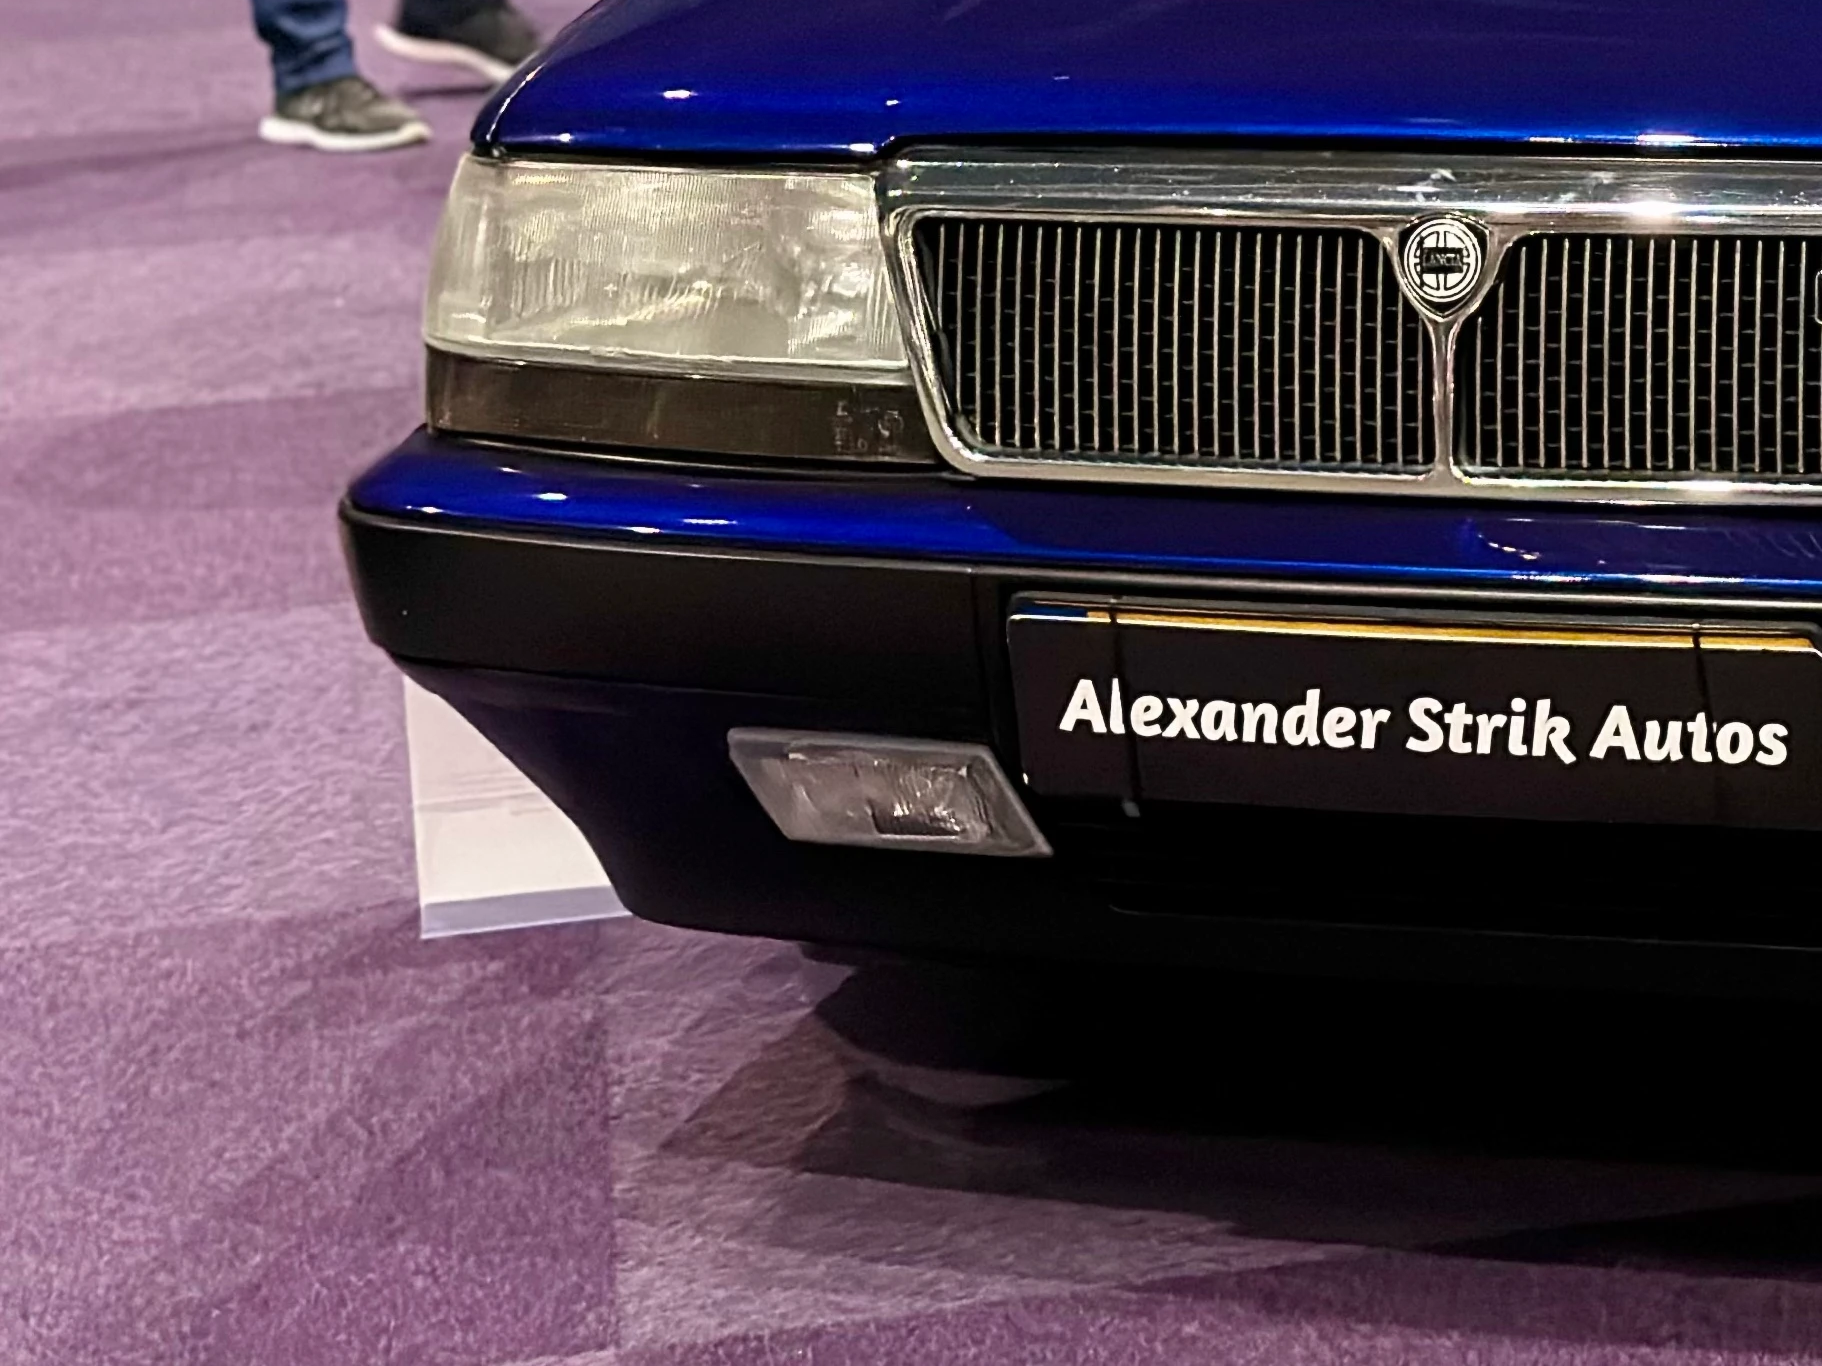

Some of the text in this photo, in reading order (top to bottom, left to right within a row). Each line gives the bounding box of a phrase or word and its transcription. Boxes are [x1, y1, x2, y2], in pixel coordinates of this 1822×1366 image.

[1058, 677, 1790, 766] Alexander Strik Autos
